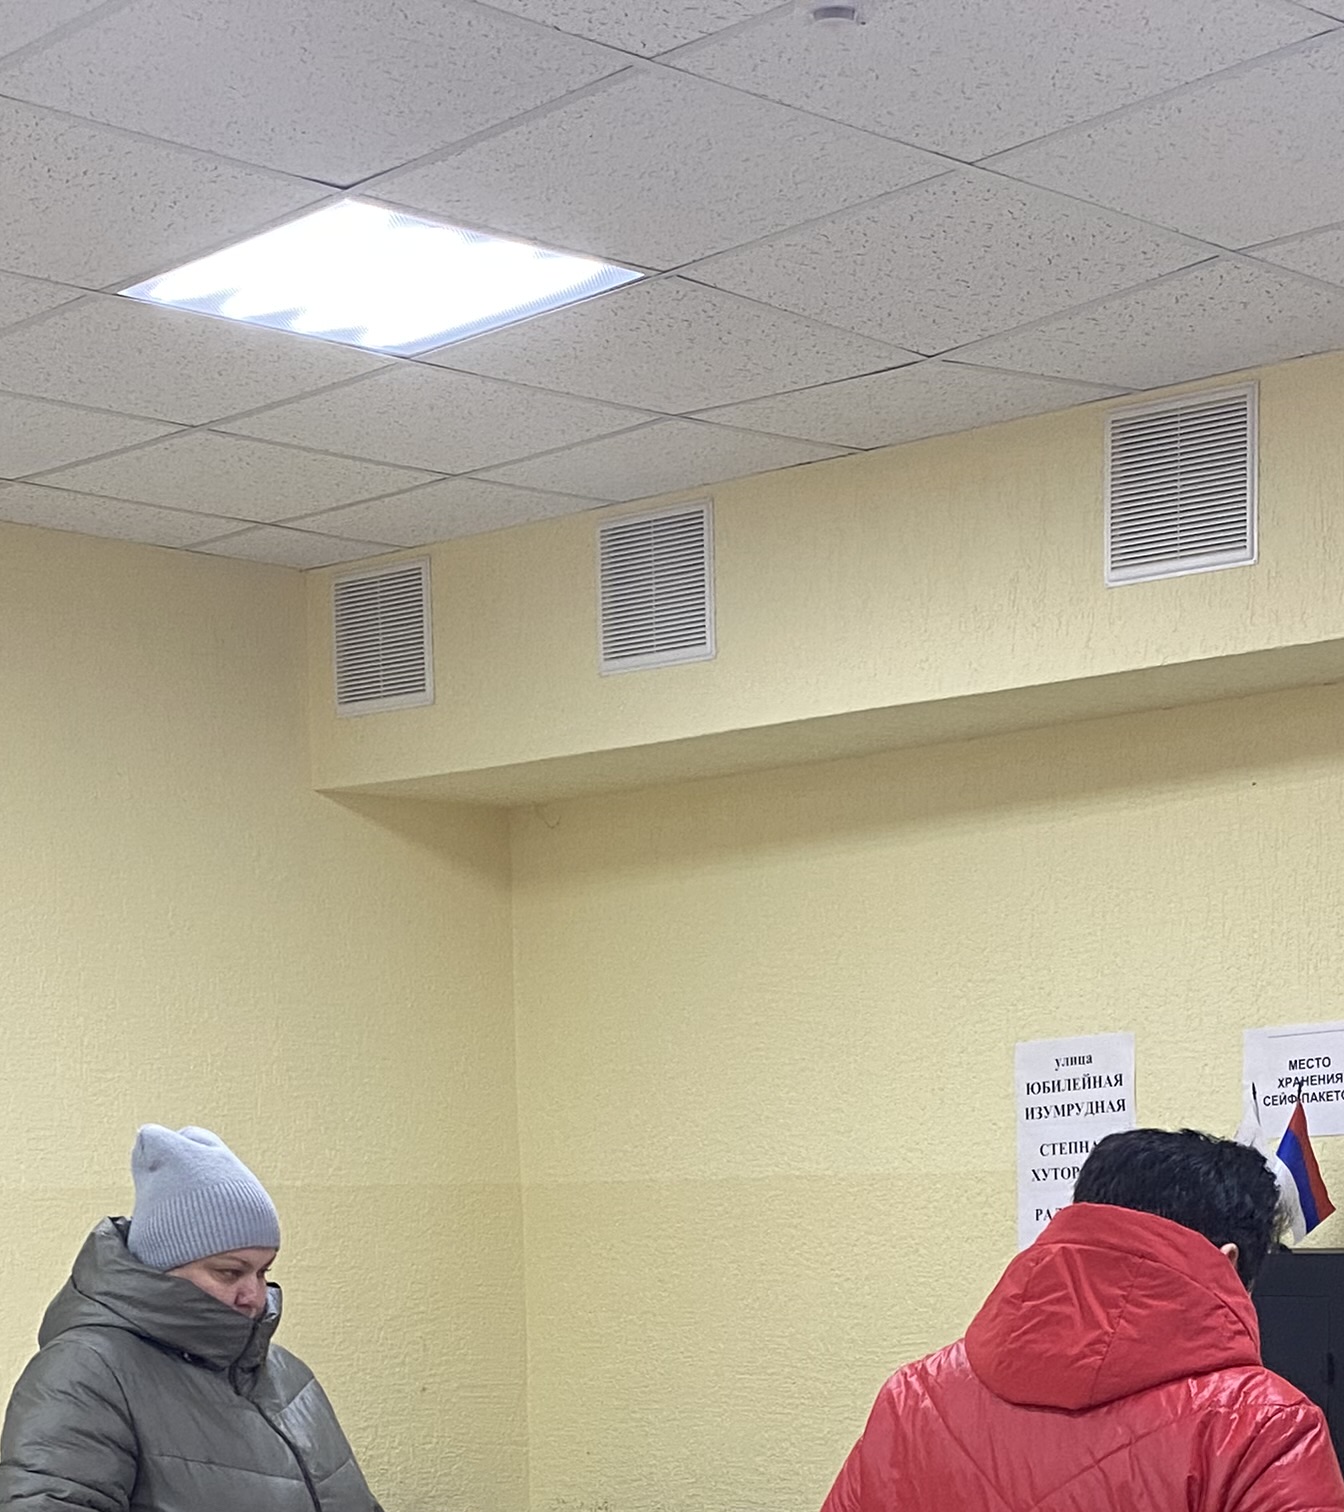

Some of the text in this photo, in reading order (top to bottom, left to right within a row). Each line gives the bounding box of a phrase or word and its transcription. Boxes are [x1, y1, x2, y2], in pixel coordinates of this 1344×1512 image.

[1054, 1053, 1094, 1072] улица
[1287, 1056, 1332, 1071] МЕСТО
[1025, 1073, 1124, 1096] ЮБИЛЕЙНАЯ
[1277, 1073, 1344, 1089] ХРАНЕНИЯ
[1024, 1098, 1127, 1121] ИЗУМРУДНАЯ
[1031, 1166, 1081, 1183] ХУТОР
